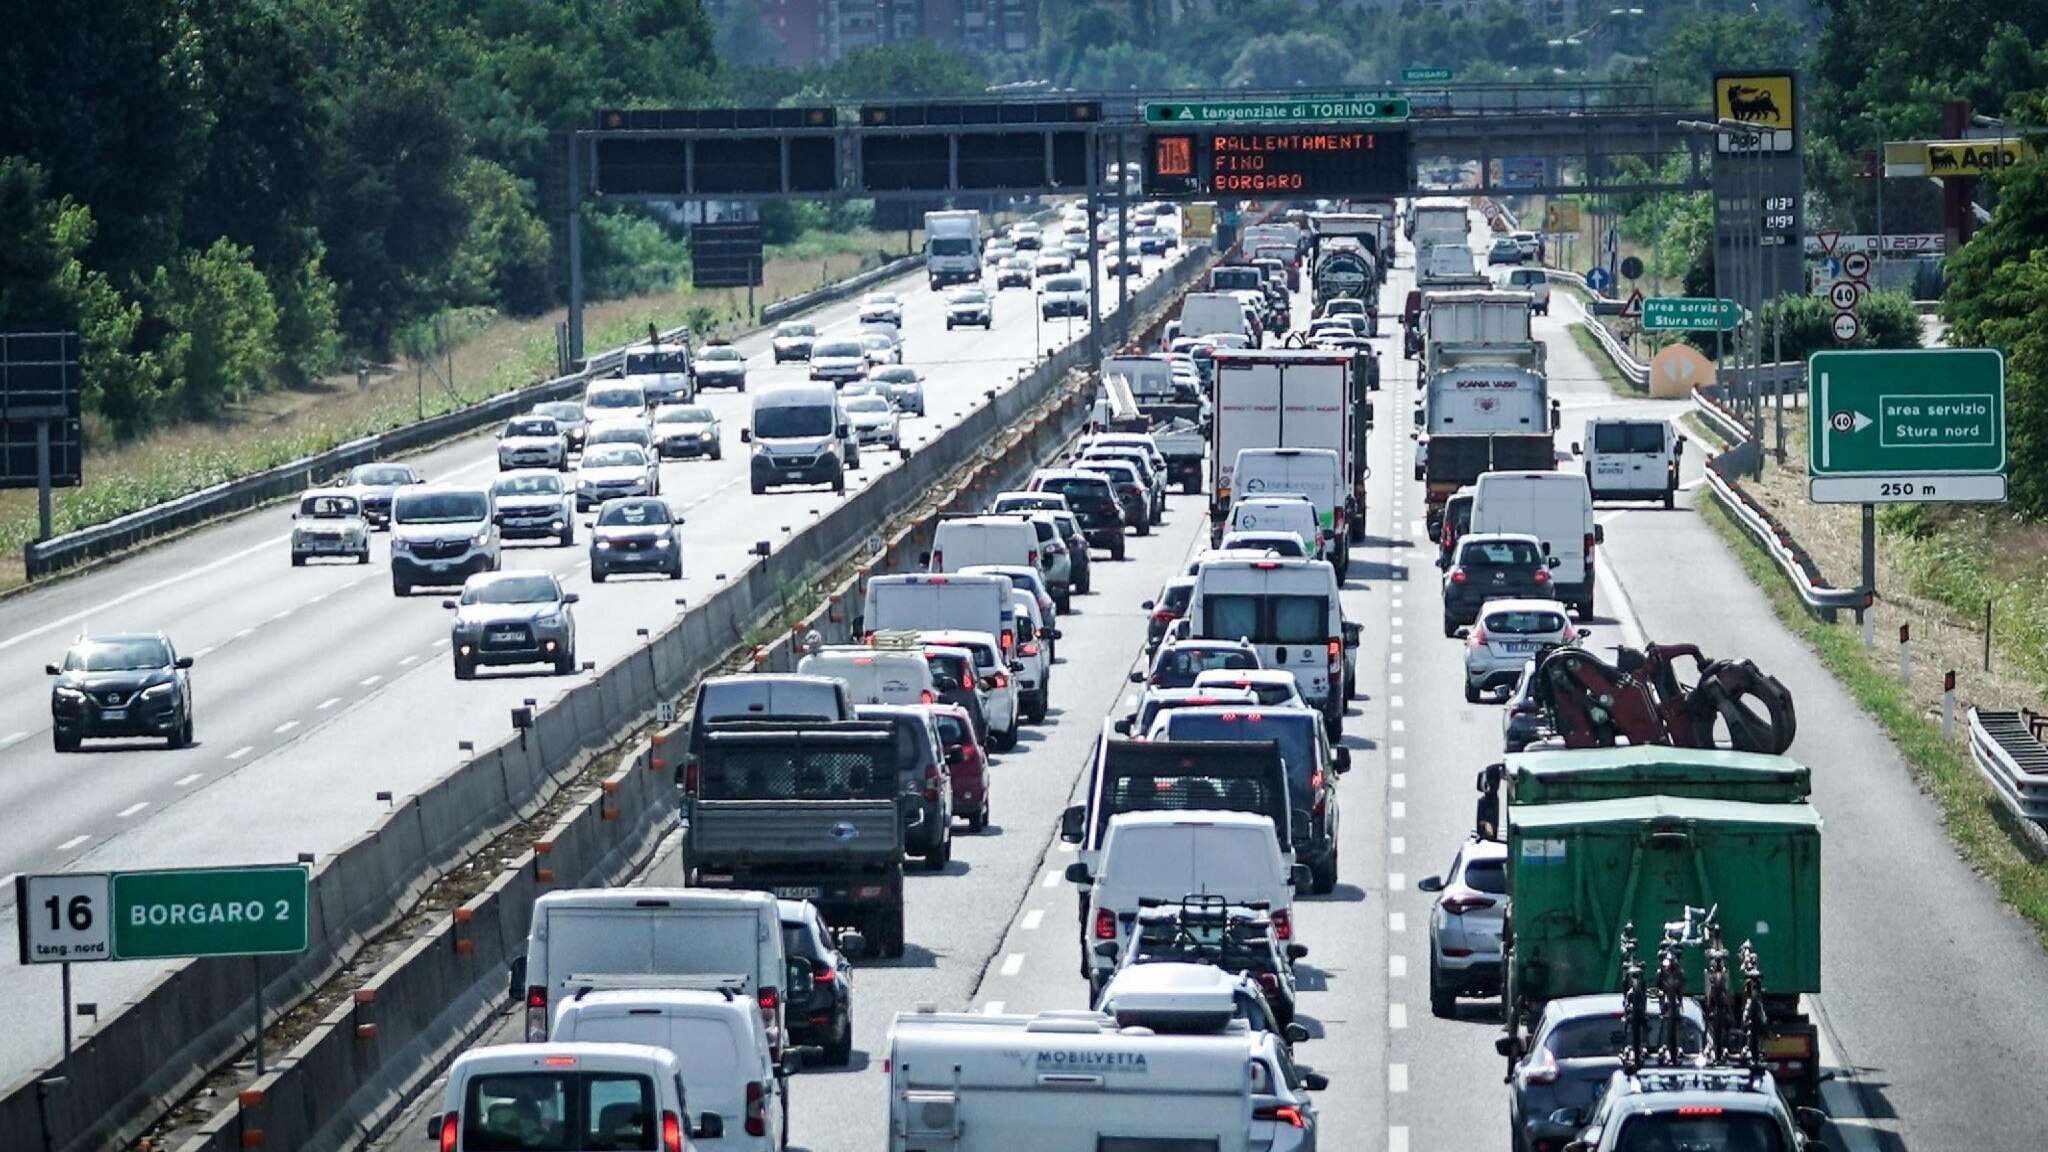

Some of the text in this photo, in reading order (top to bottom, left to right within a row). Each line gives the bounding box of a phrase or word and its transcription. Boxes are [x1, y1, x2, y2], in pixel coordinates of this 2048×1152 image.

[1202, 103, 1376, 121] tangenziale di TORINO
[1215, 133, 1375, 151] RALLENTAMENTI
[1215, 156, 1264, 171] FINO
[1961, 145, 2016, 171] Agip
[1215, 175, 1302, 190] BORGARO
[1836, 289, 1853, 302] 40
[1648, 302, 1729, 312] area servizo
[1655, 315, 1688, 326] Stura
[1886, 402, 1986, 417] area servizio
[1836, 416, 1849, 428] 40
[1896, 423, 1979, 438] Stura nord
[1880, 482, 1936, 496] 250 m
[45, 895, 93, 931] 16
[131, 900, 289, 926] BORGARO 2
[75, 942, 104, 954] nord
[1037, 1051, 1146, 1065] MOBILVETTA
